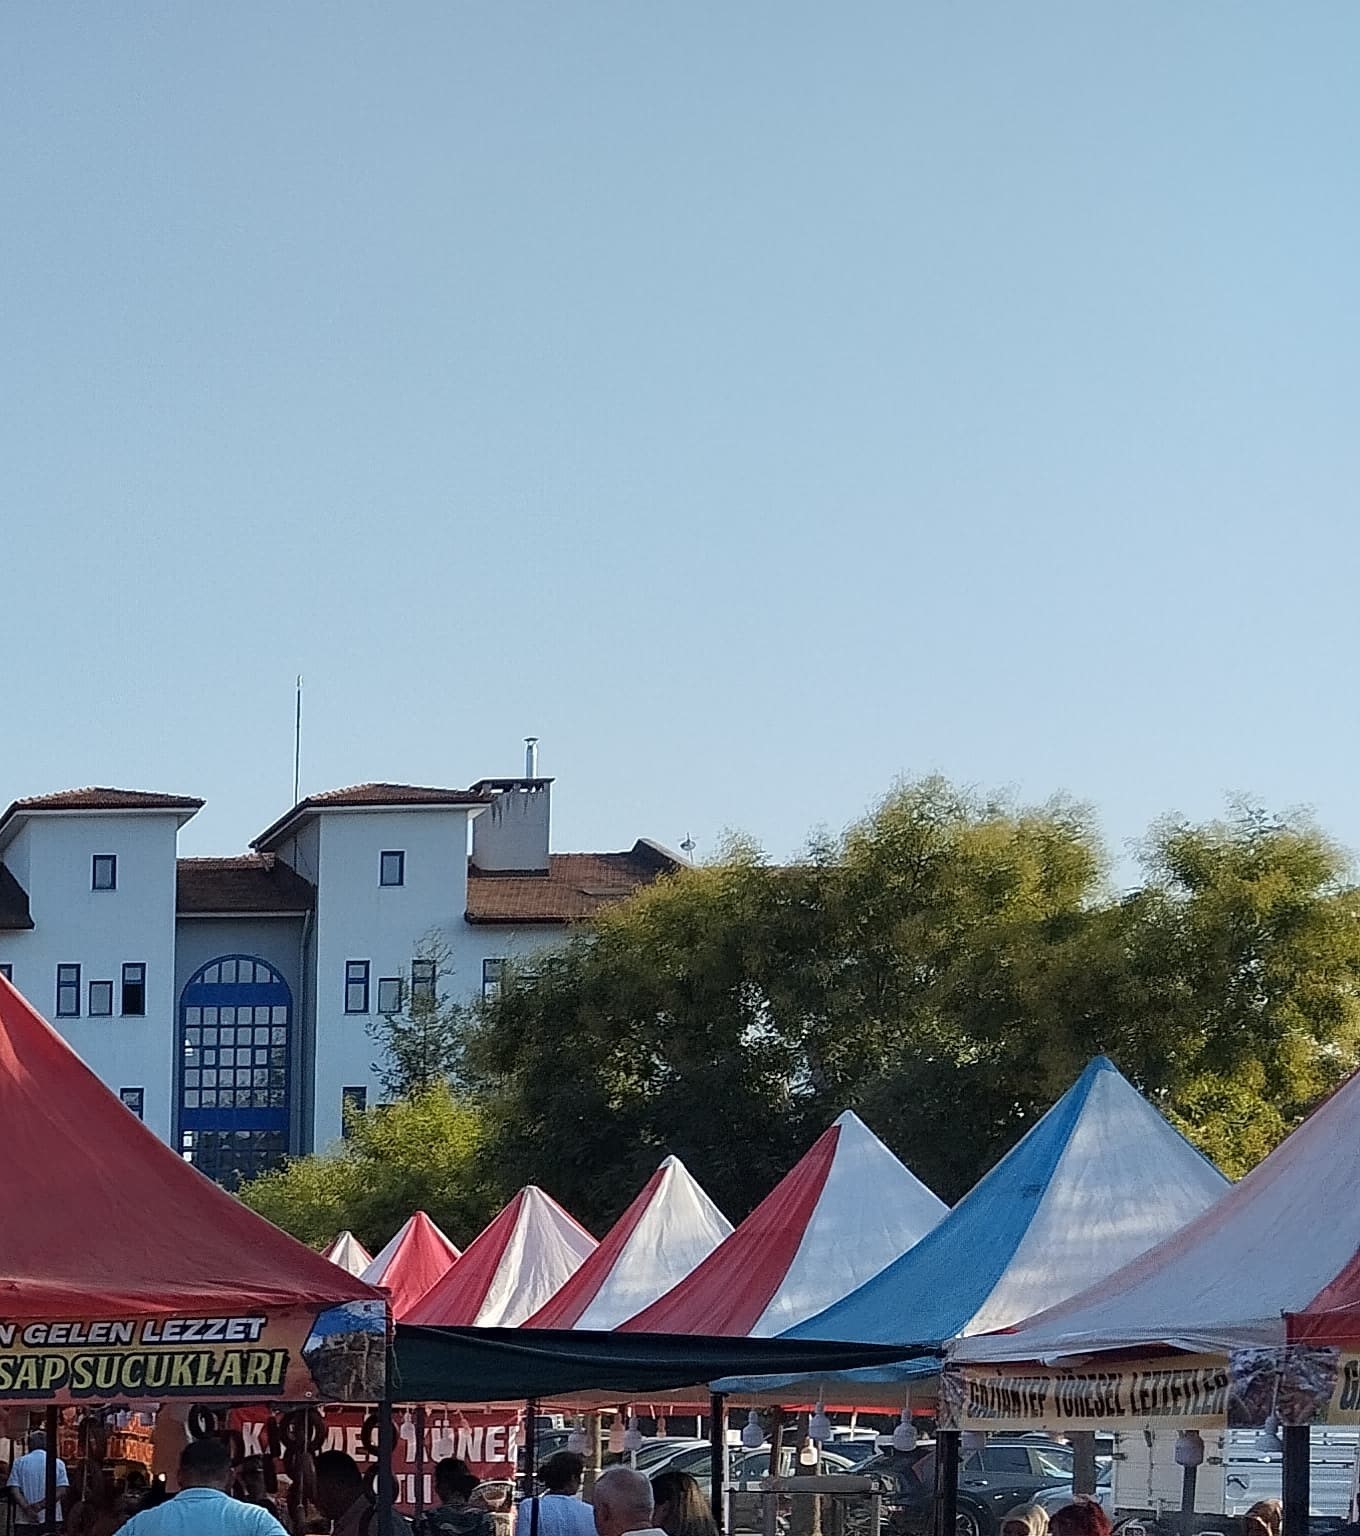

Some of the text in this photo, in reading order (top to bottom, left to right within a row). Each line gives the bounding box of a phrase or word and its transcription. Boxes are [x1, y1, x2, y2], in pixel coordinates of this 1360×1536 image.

[23, 1321, 132, 1345] GELEN
[142, 1316, 266, 1343] LEZZET
[71, 1350, 288, 1389] SUCUKLARI
